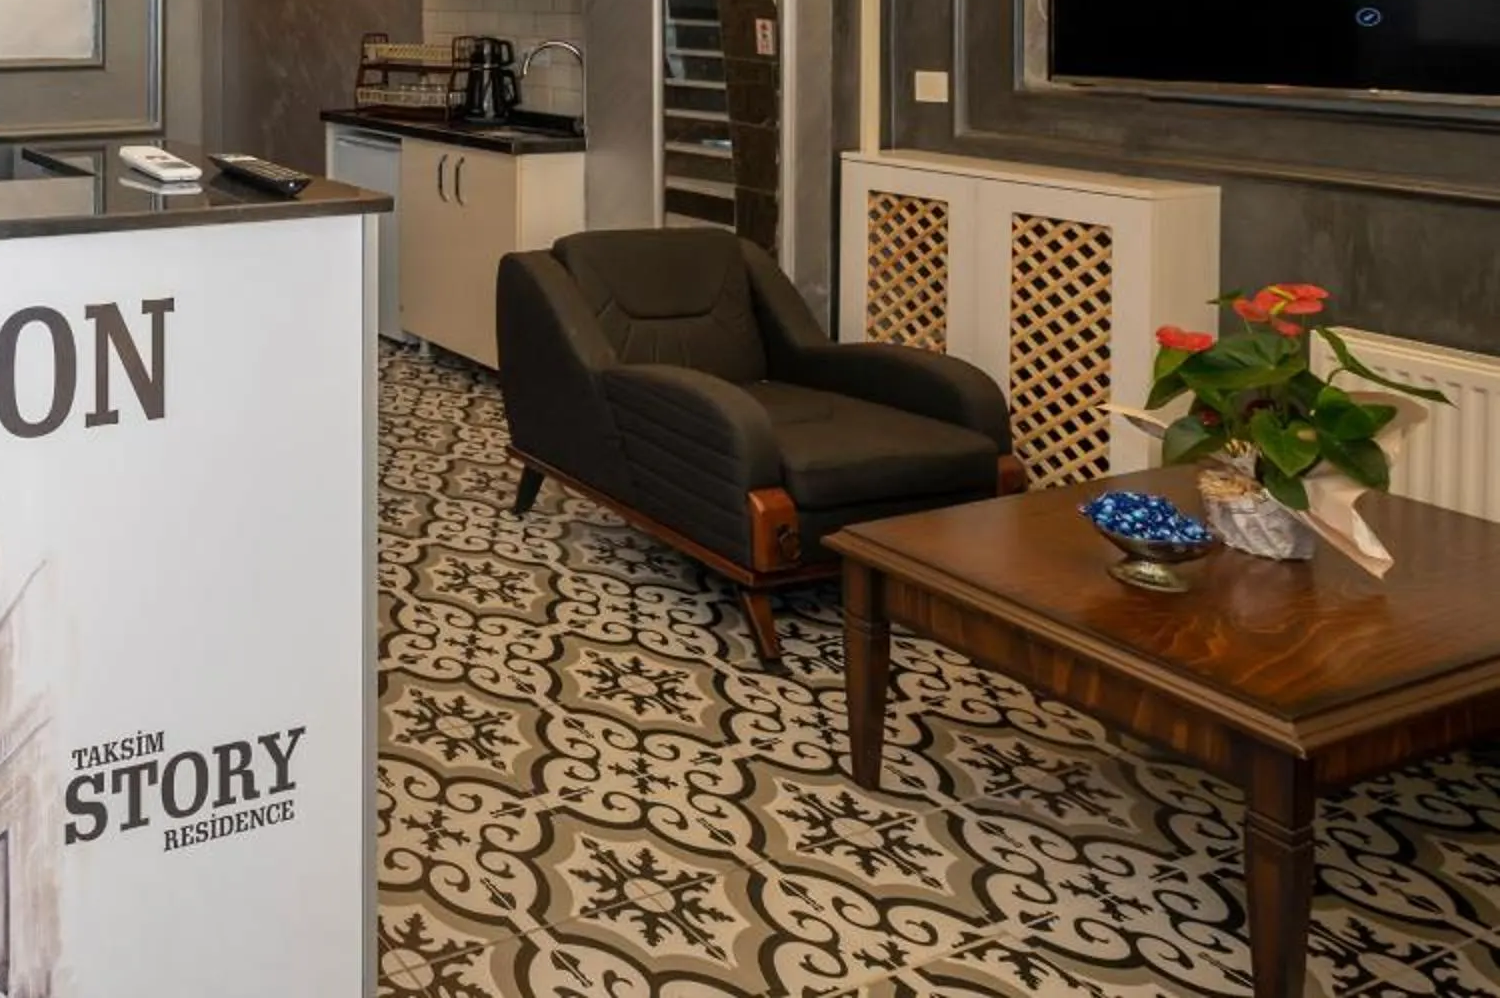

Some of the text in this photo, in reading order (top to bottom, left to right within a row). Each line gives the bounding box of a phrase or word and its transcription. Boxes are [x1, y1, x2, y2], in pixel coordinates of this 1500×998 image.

[71, 730, 165, 771] TAKSİM
[64, 725, 306, 846] STORY
[163, 800, 295, 852] RESİDENCE
